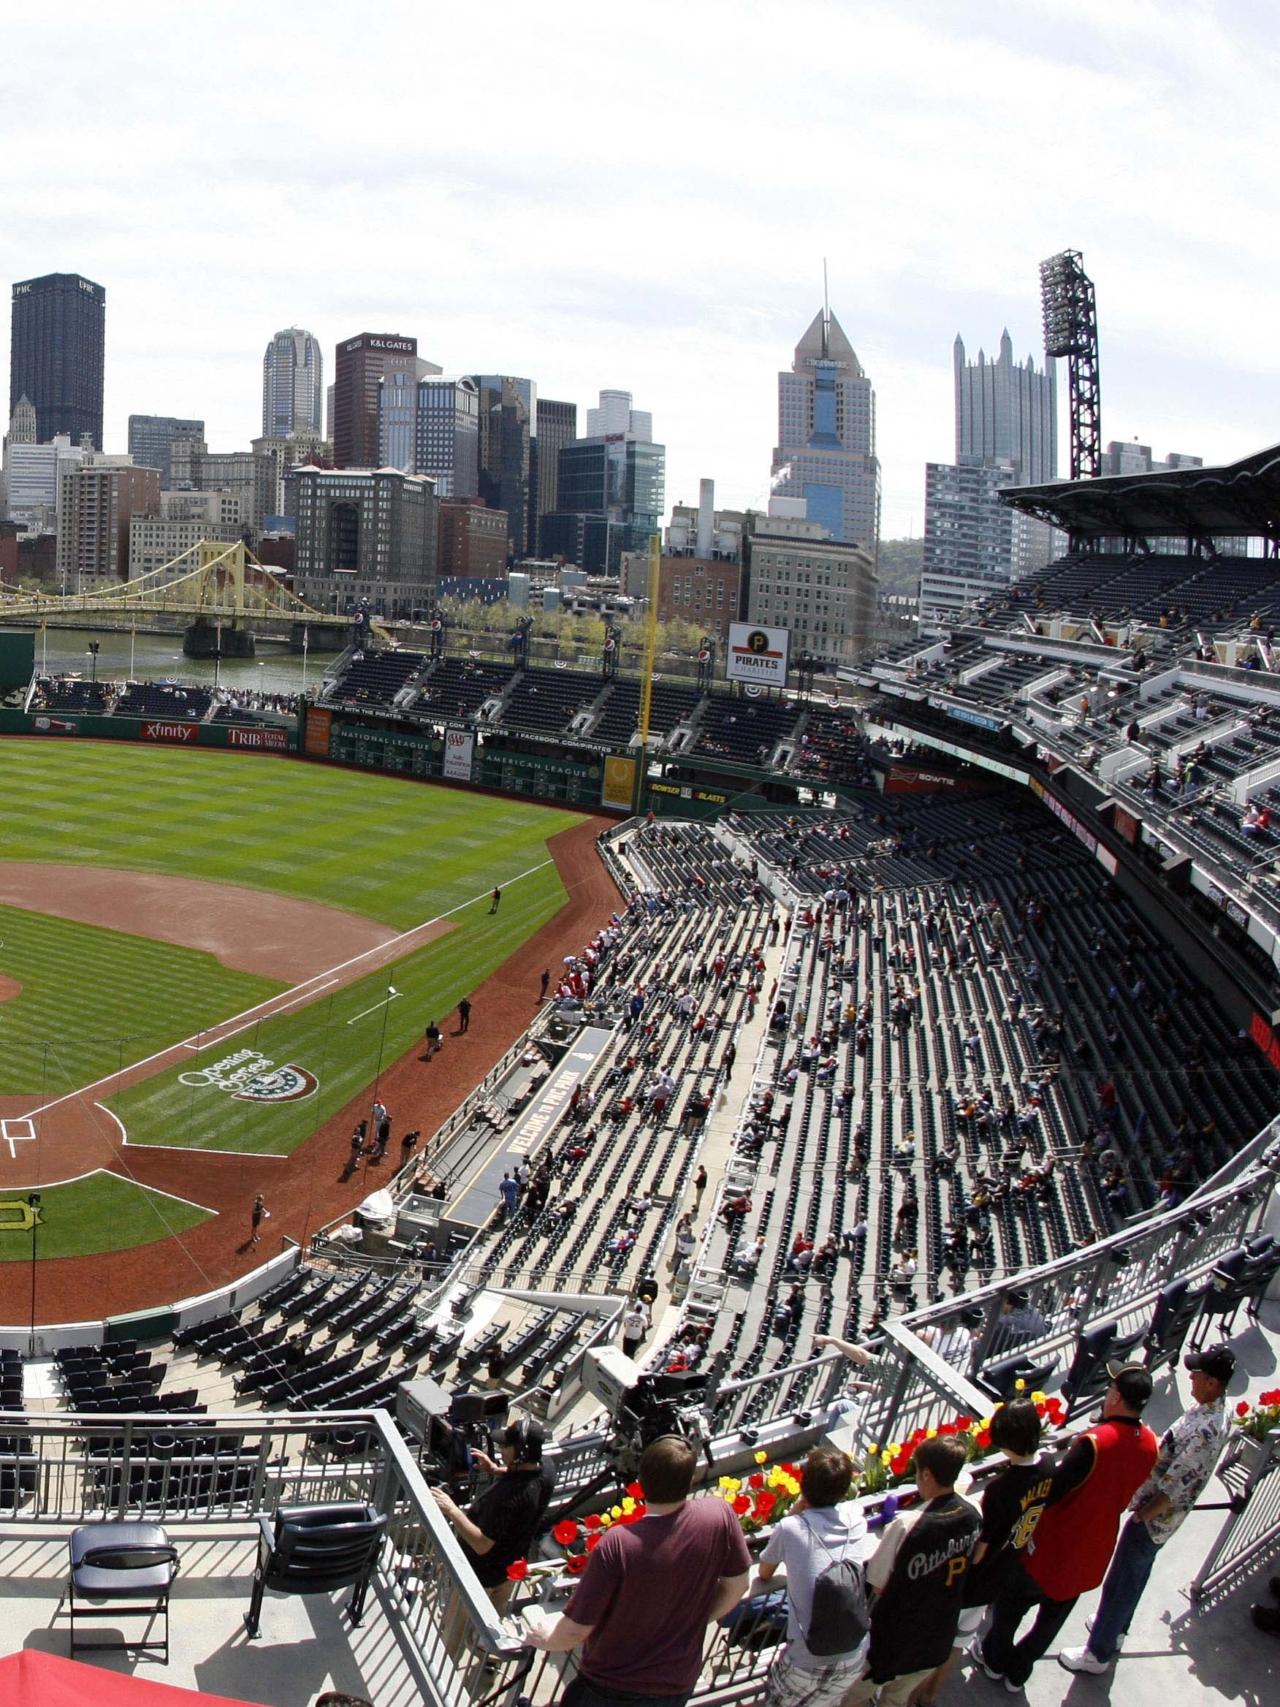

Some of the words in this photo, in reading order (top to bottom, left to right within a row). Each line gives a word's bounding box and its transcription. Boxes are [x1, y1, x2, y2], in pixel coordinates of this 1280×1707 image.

[370, 339, 386, 348] K&L
[386, 341, 413, 351] GATES
[753, 635, 764, 651] P
[734, 665, 777, 676] CHARITIES
[735, 655, 778, 670] PIRATES
[313, 702, 343, 712] CONNECT
[374, 710, 402, 719] PIRATES
[147, 722, 192, 741] xfinity
[228, 729, 260, 745] TRIB
[341, 730, 390, 744] NATIONAL
[392, 739, 429, 751] LEAGUE
[486, 755, 541, 769] AMERICAN
[545, 764, 587, 778] LEAGUE
[178, 1048, 264, 1087] Opening
[211, 1058, 274, 1091] Series
[506, 1112, 551, 1154] WELCOME
[945, 1555, 969, 1586] P
